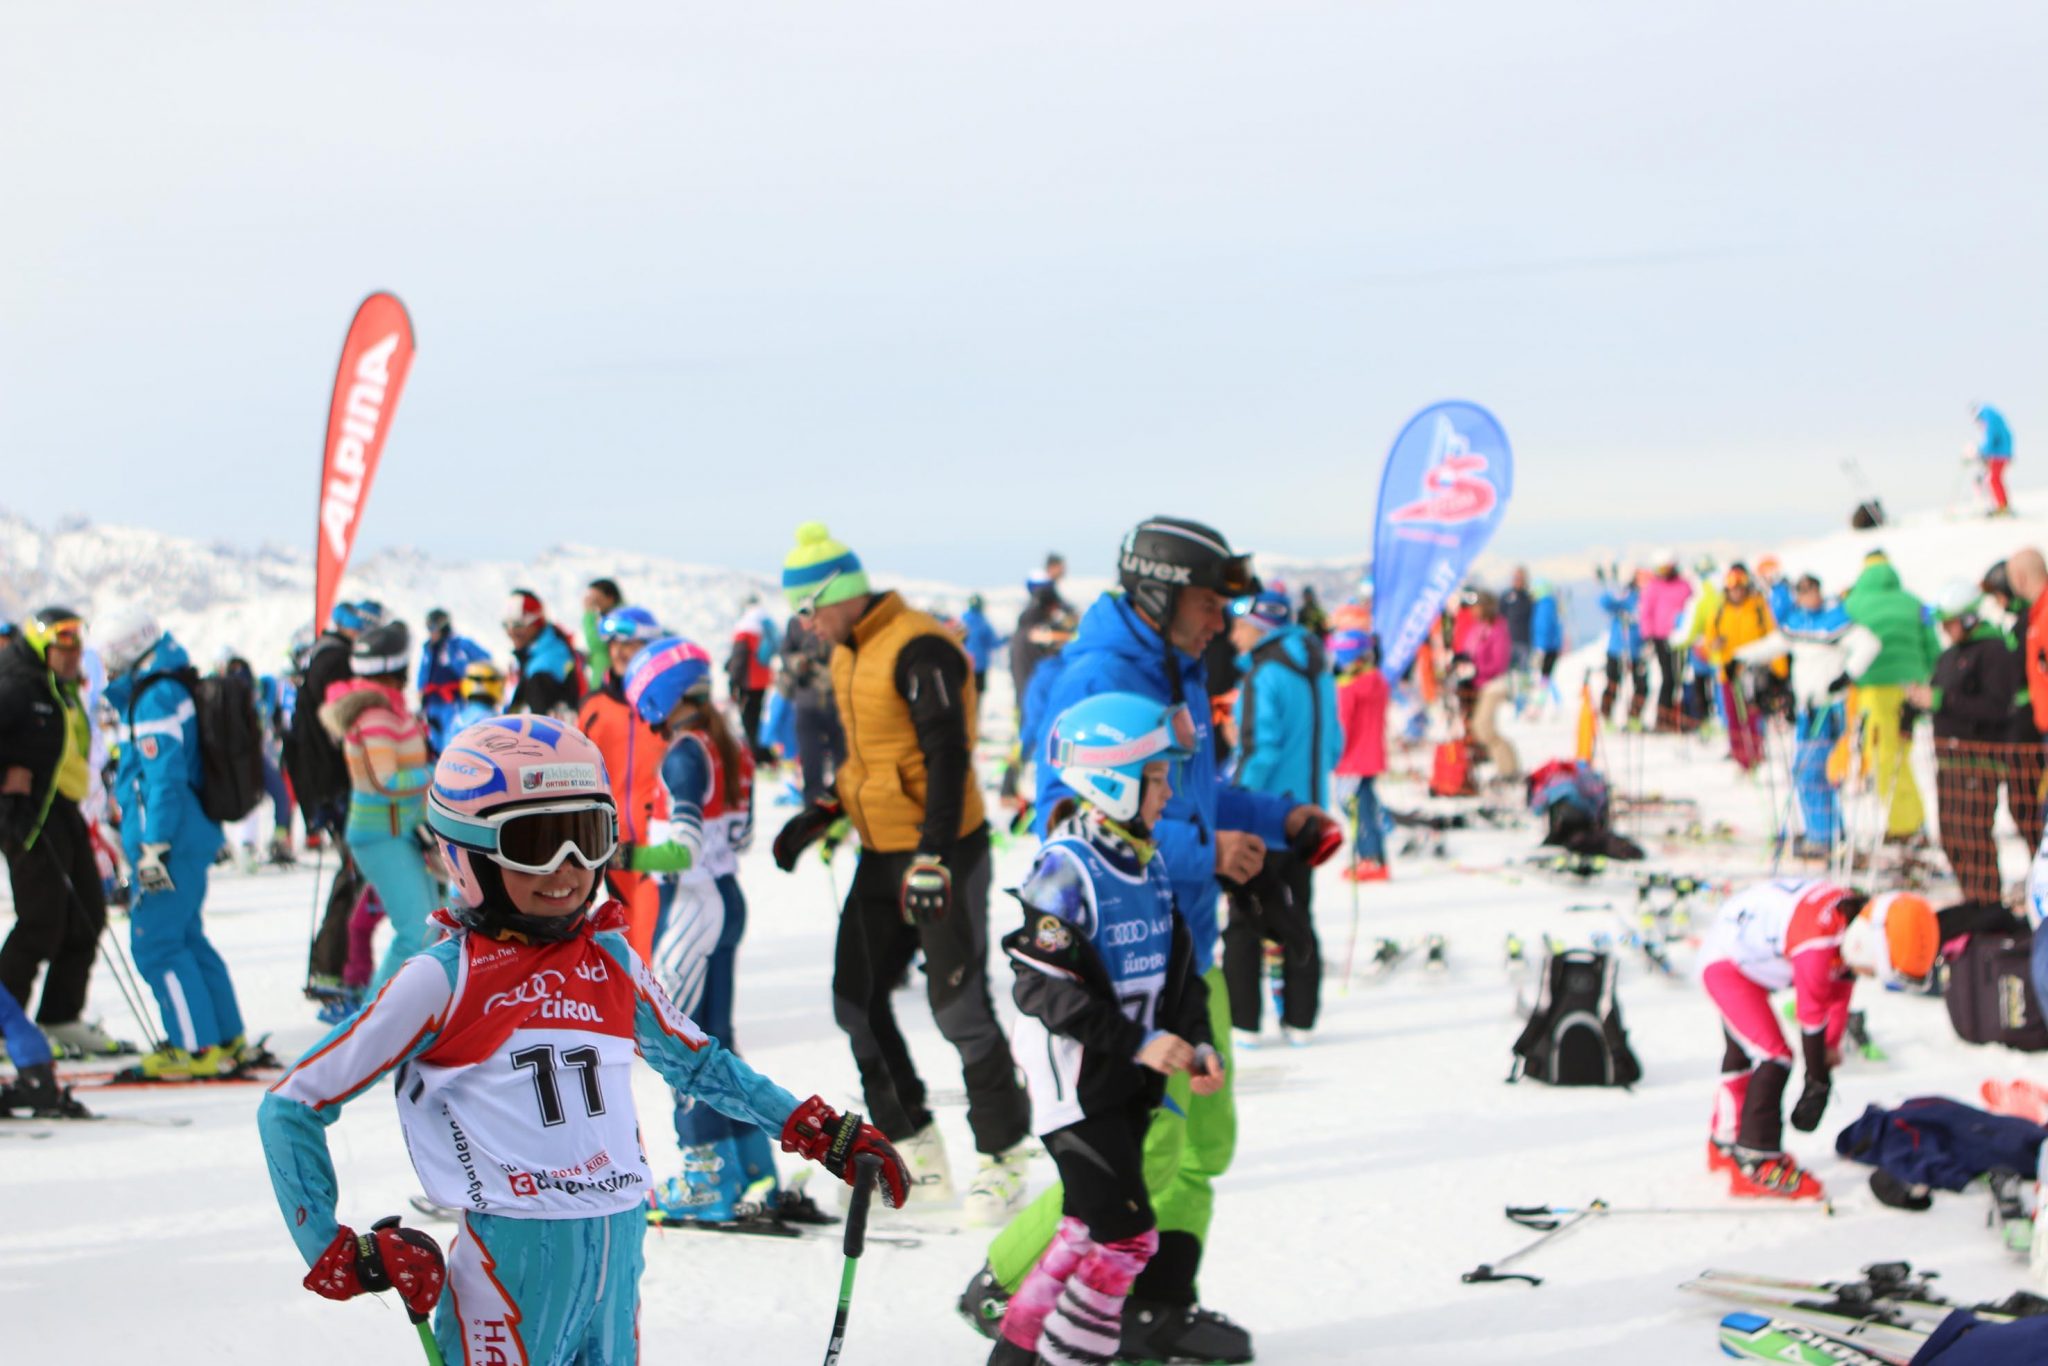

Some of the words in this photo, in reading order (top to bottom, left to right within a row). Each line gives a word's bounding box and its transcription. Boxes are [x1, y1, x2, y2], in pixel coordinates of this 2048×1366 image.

[321, 332, 400, 561] ALPINA
[1122, 554, 1191, 584] uvex
[510, 1044, 606, 1127] 11
[551, 1165, 582, 1179] 2016
[585, 1152, 610, 1173] KIDS
